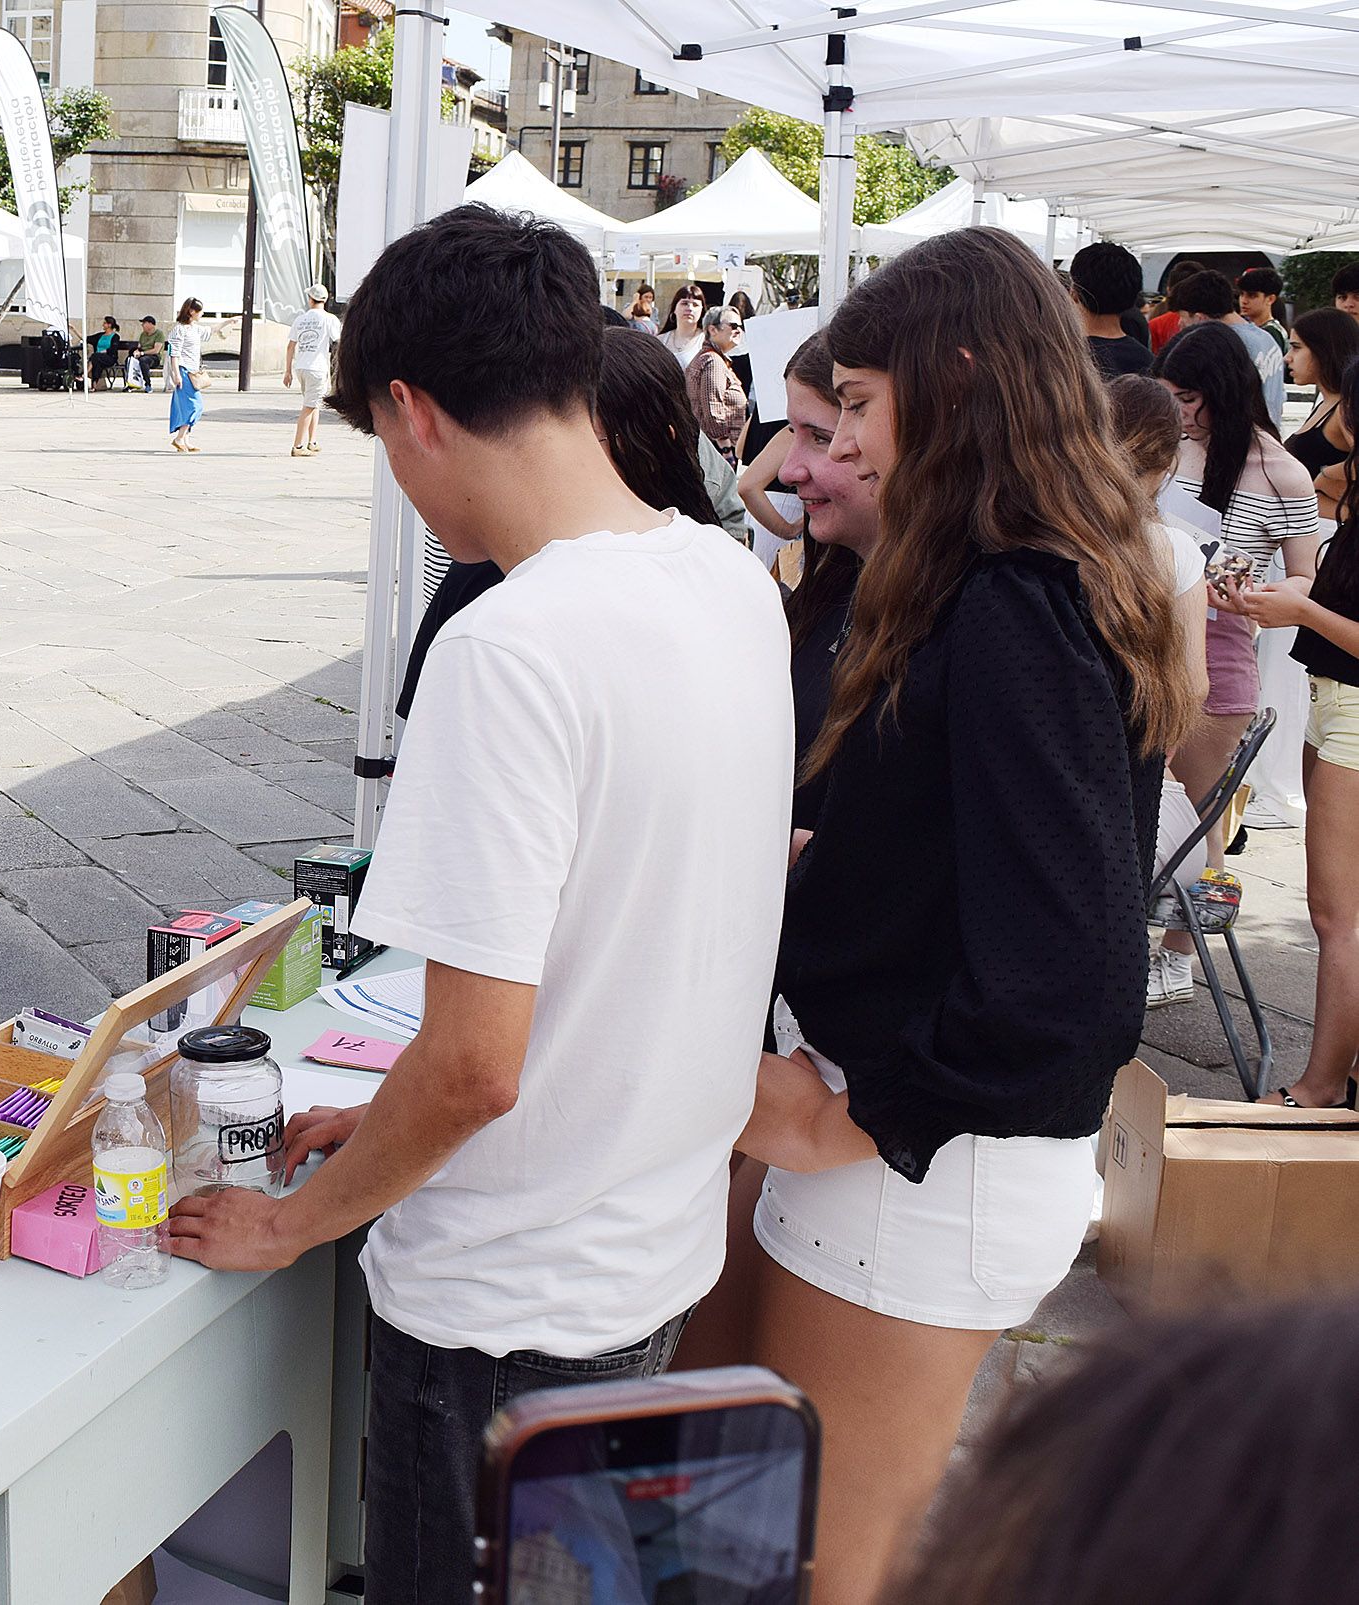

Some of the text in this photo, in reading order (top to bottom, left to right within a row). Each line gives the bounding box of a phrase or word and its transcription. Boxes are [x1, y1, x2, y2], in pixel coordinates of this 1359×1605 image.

[215, 198, 246, 208] Carabela
[29, 1034, 59, 1051] ORBALLO
[53, 1185, 88, 1217] SORTEO
